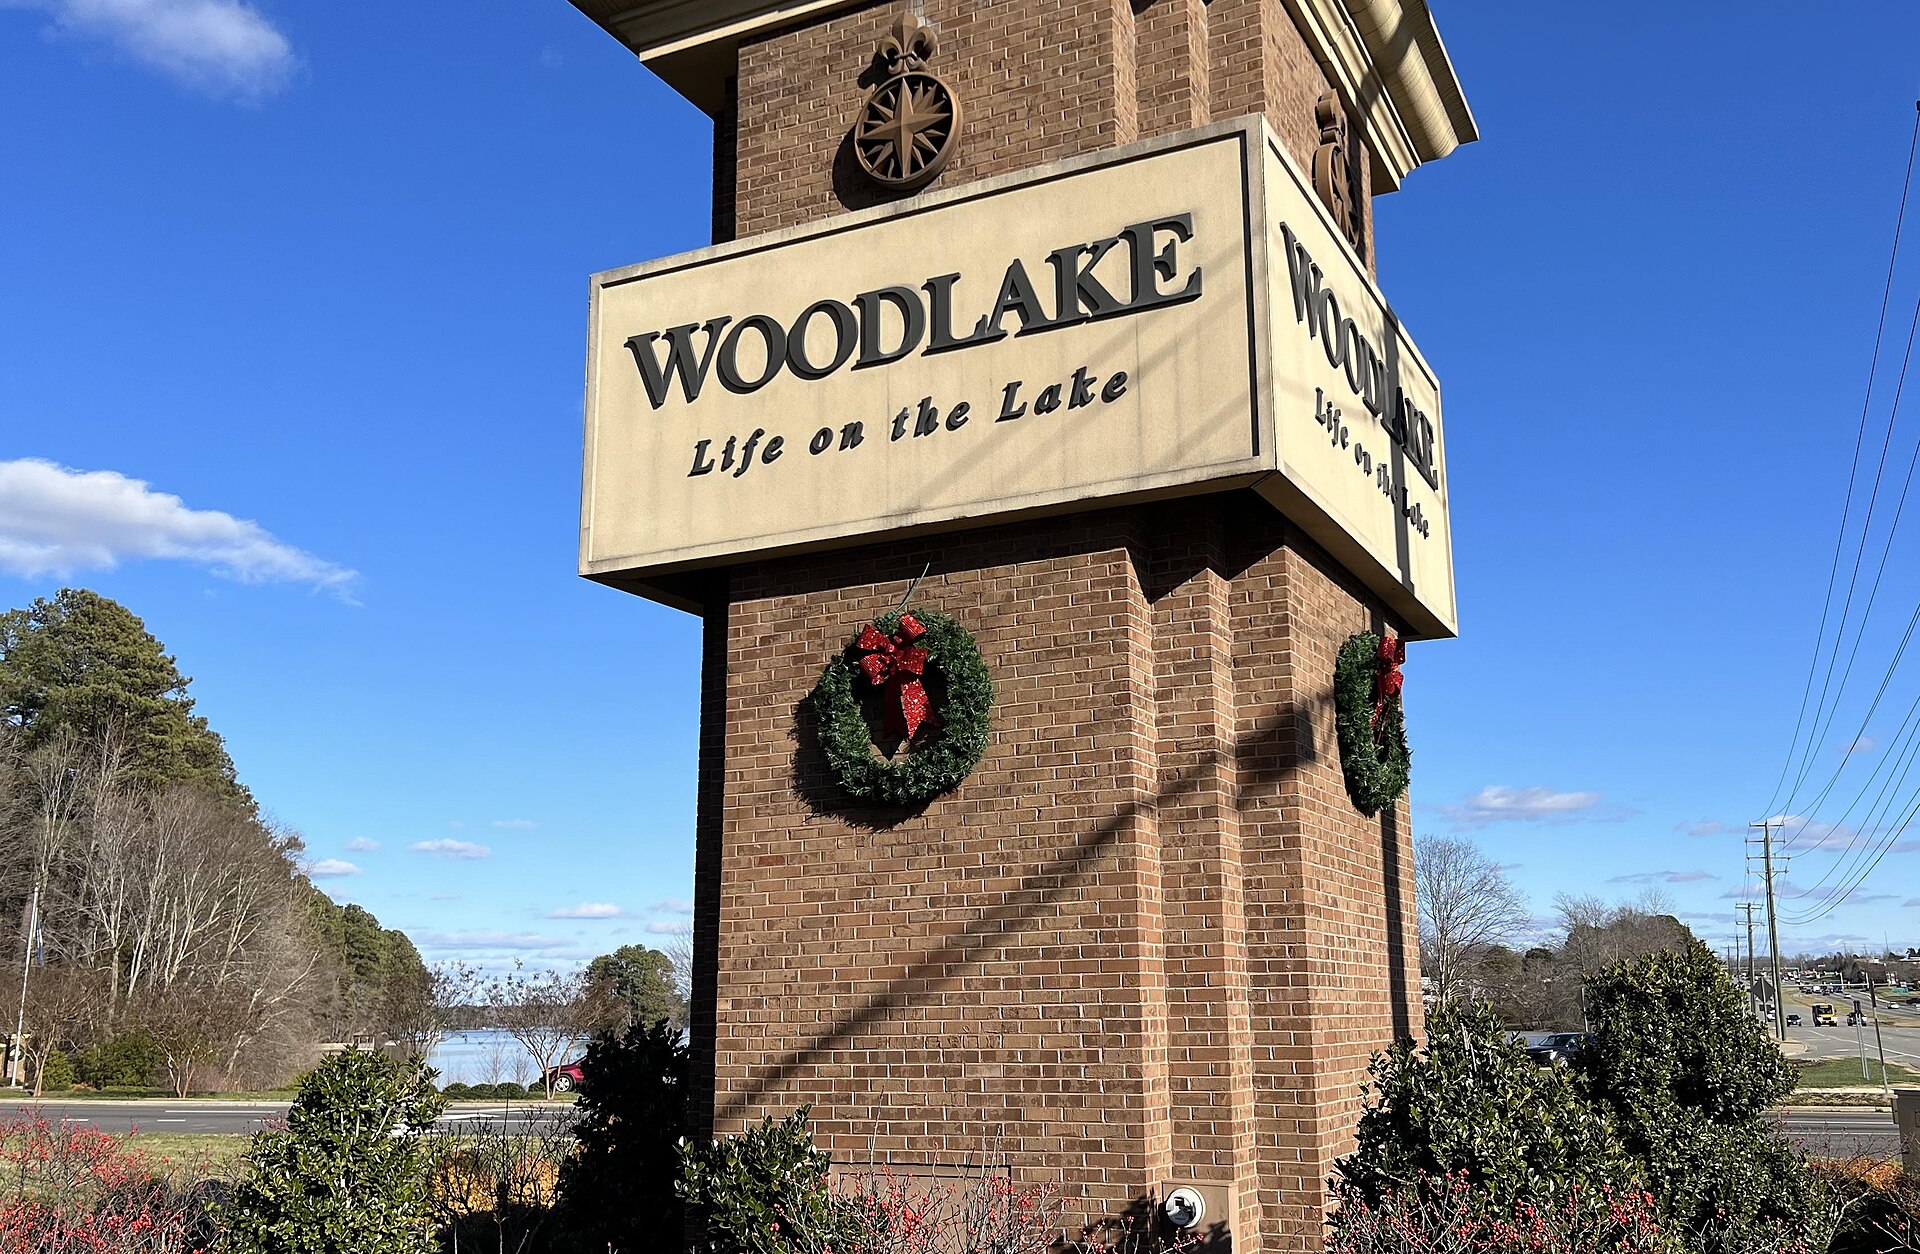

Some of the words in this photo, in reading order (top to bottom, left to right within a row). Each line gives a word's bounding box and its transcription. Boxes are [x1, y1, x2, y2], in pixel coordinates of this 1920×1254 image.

[624, 212, 1202, 410] WOODLAKE
[1279, 221, 1438, 492] WOODLAKE
[687, 428, 784, 478] Life
[809, 421, 864, 455] on
[891, 396, 970, 442] the
[995, 366, 1128, 423] Lake
[1315, 387, 1349, 450] Life
[1354, 442, 1373, 477] on
[1376, 463, 1398, 505] the
[1402, 487, 1429, 540] Lake
